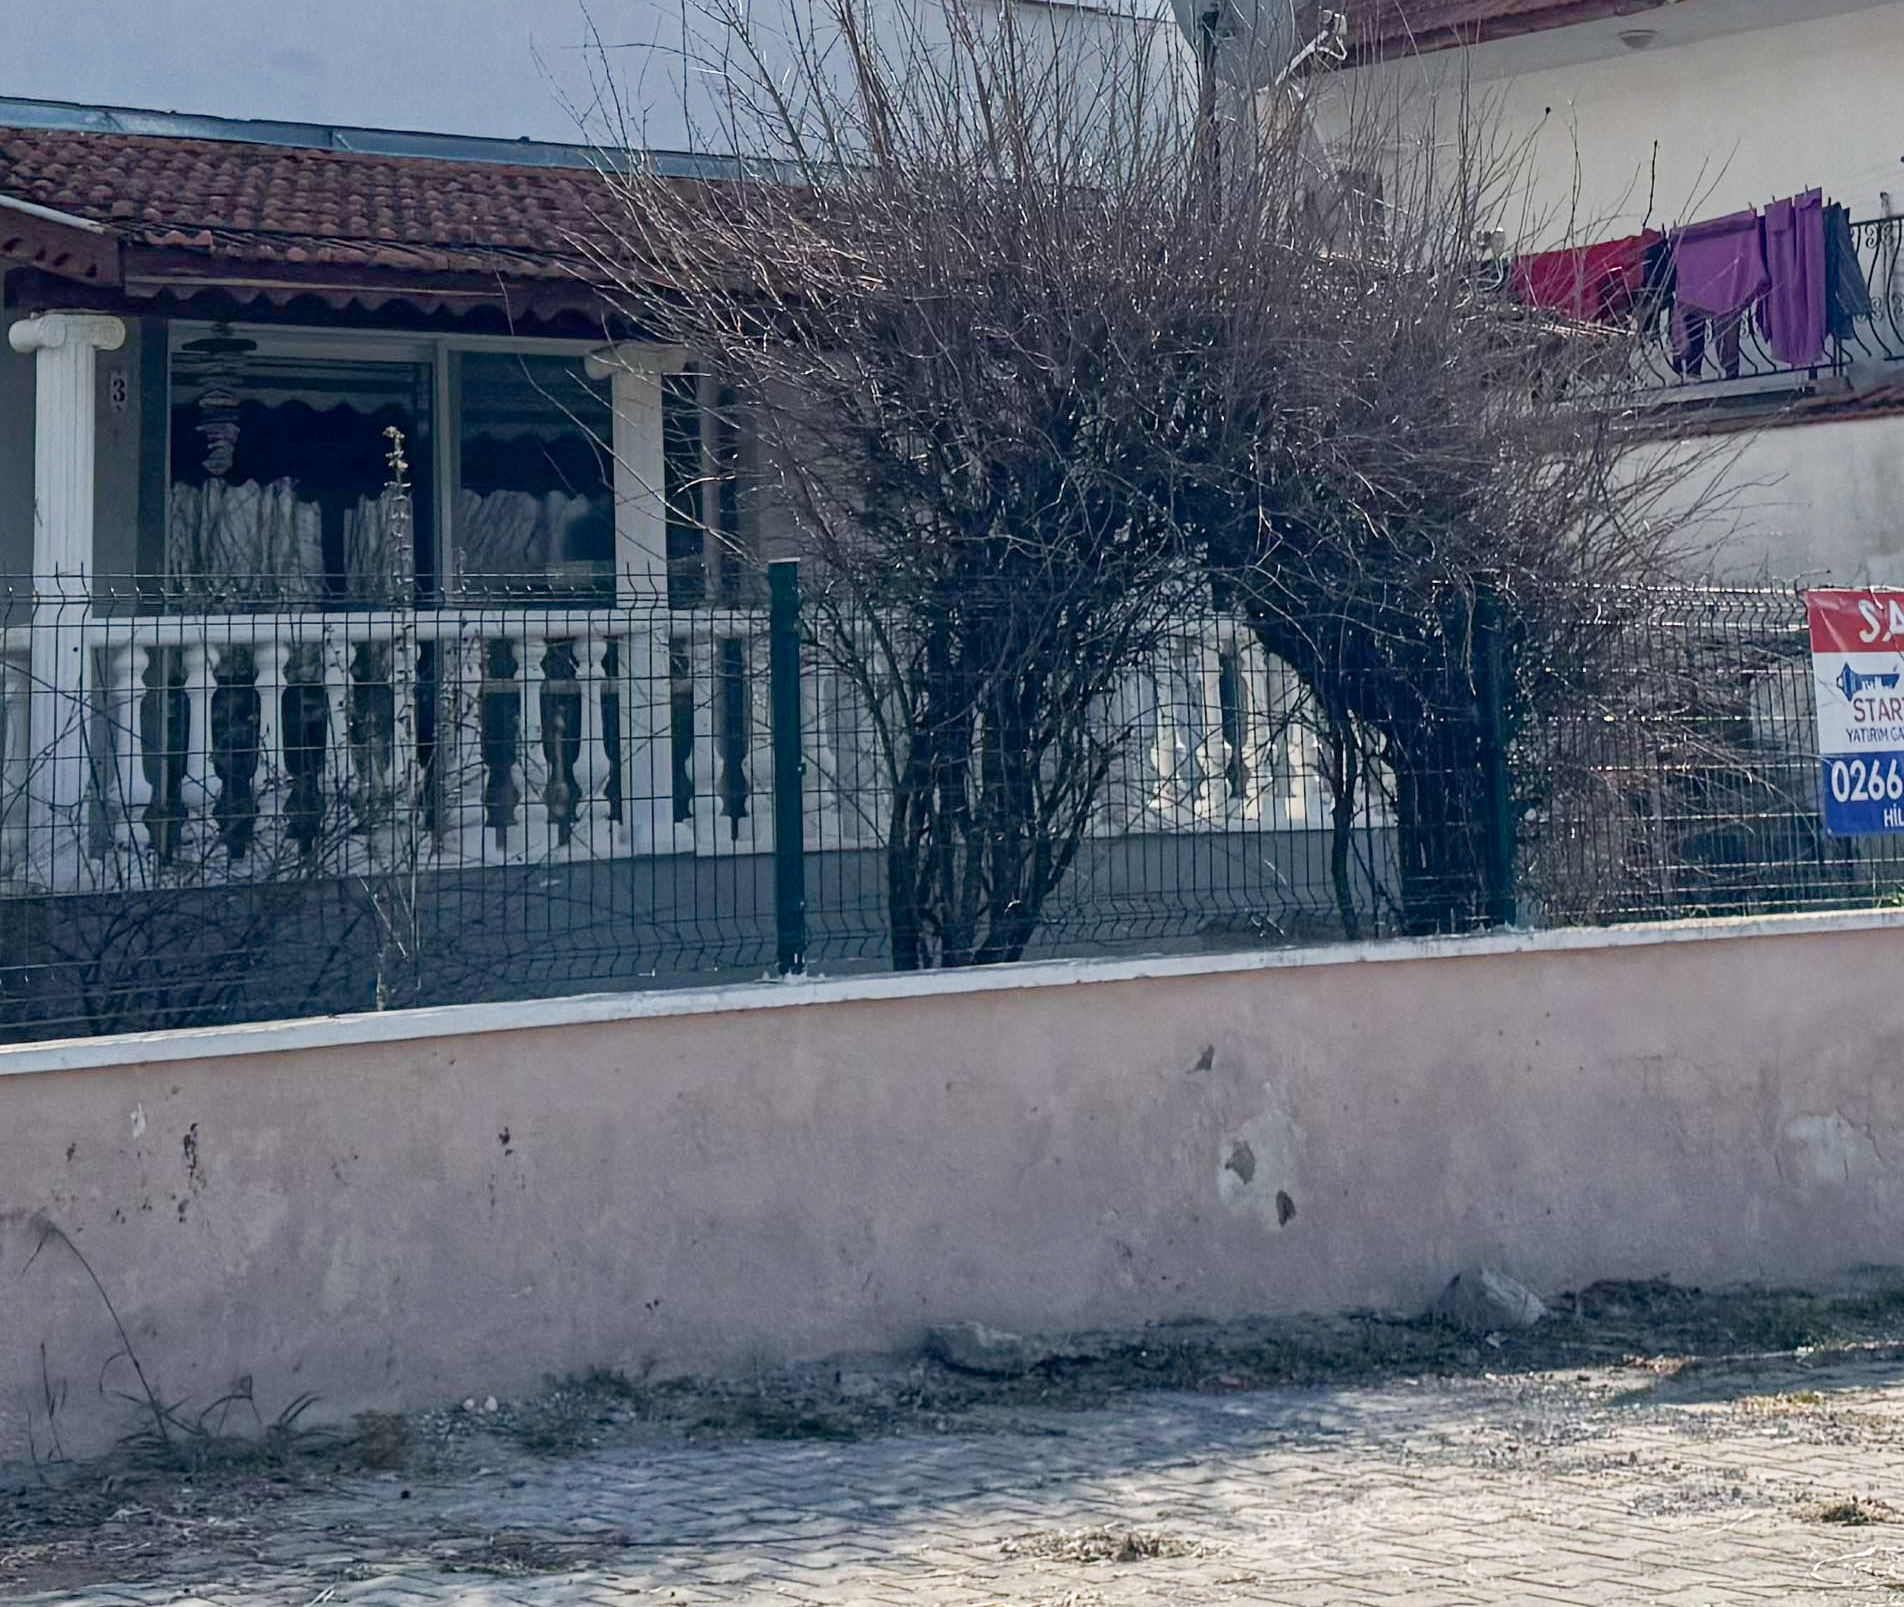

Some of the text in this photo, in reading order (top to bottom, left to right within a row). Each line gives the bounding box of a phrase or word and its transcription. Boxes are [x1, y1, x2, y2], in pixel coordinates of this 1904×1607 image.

[113, 378, 125, 402] 3
[1846, 727, 1889, 742] YATIRIM
[1831, 758, 1903, 803] 0266
